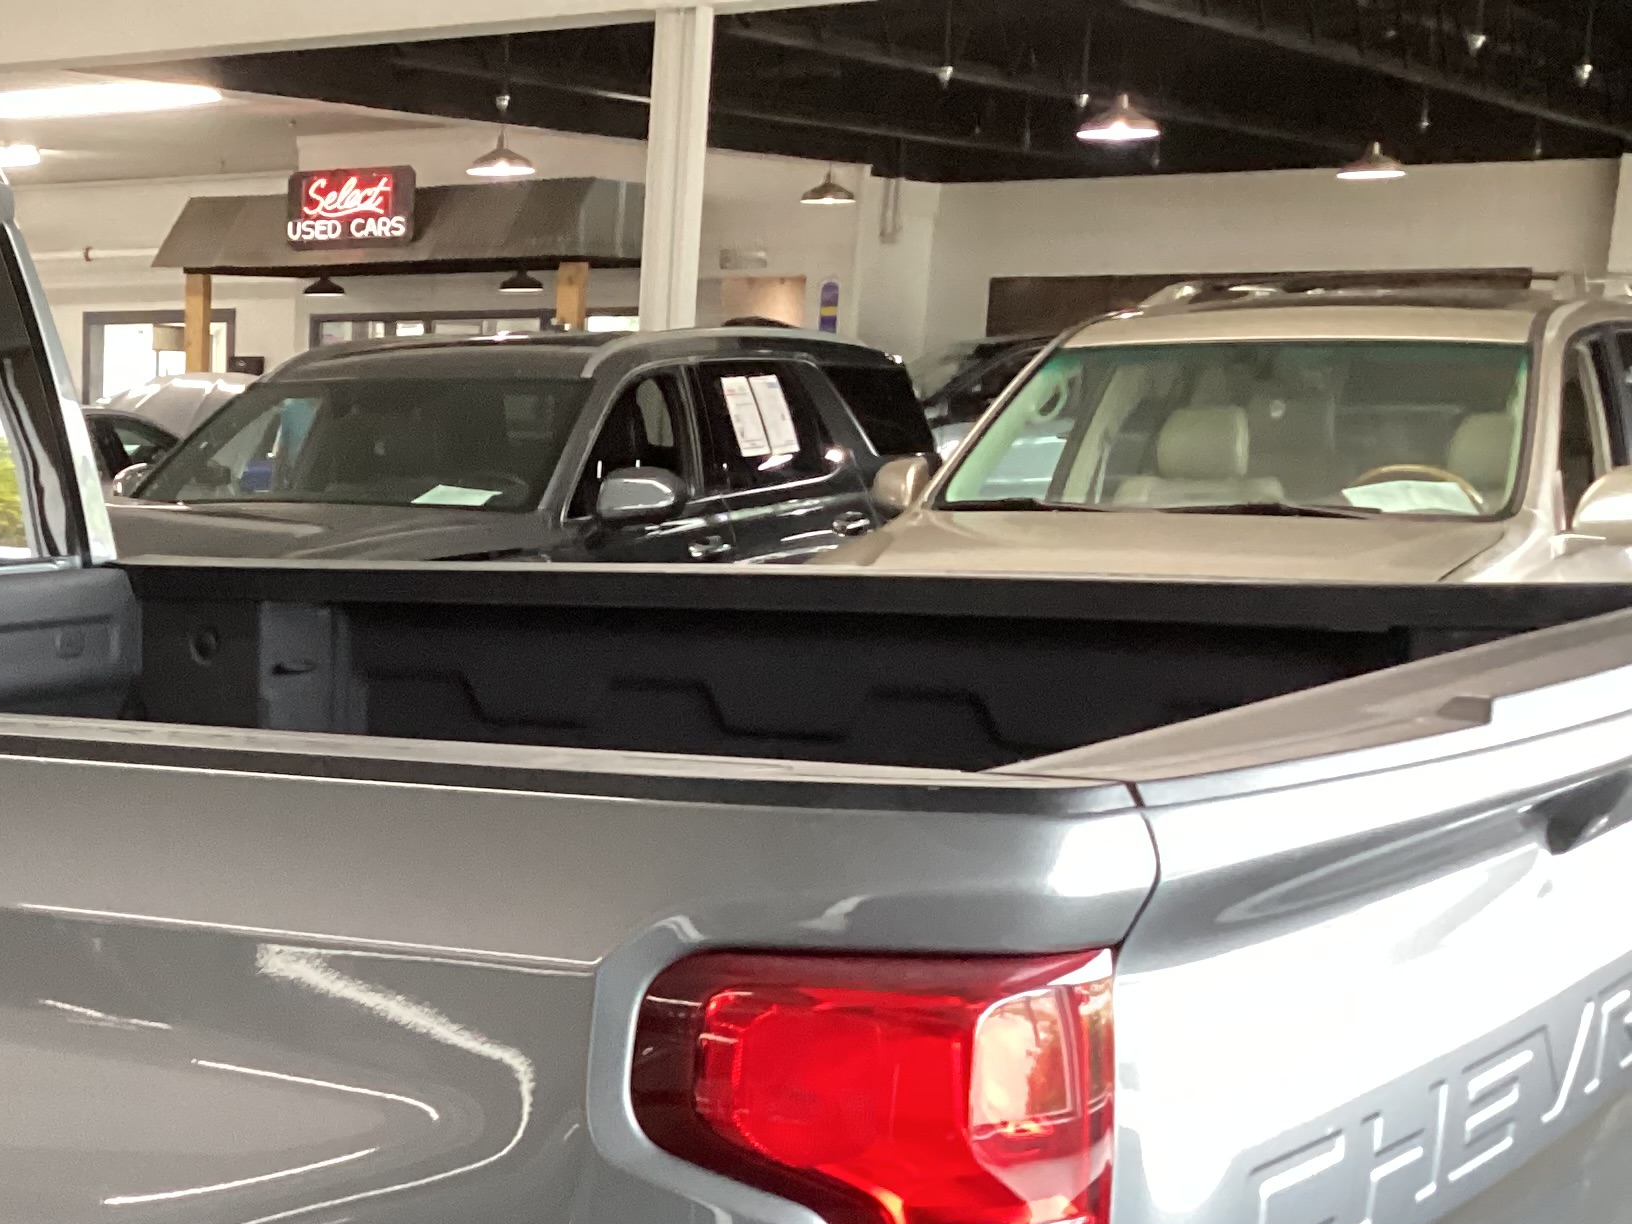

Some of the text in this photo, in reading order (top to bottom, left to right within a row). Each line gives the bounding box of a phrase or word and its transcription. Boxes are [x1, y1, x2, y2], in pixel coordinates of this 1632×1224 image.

[302, 176, 391, 217] Select
[287, 215, 407, 241] USED CARS
